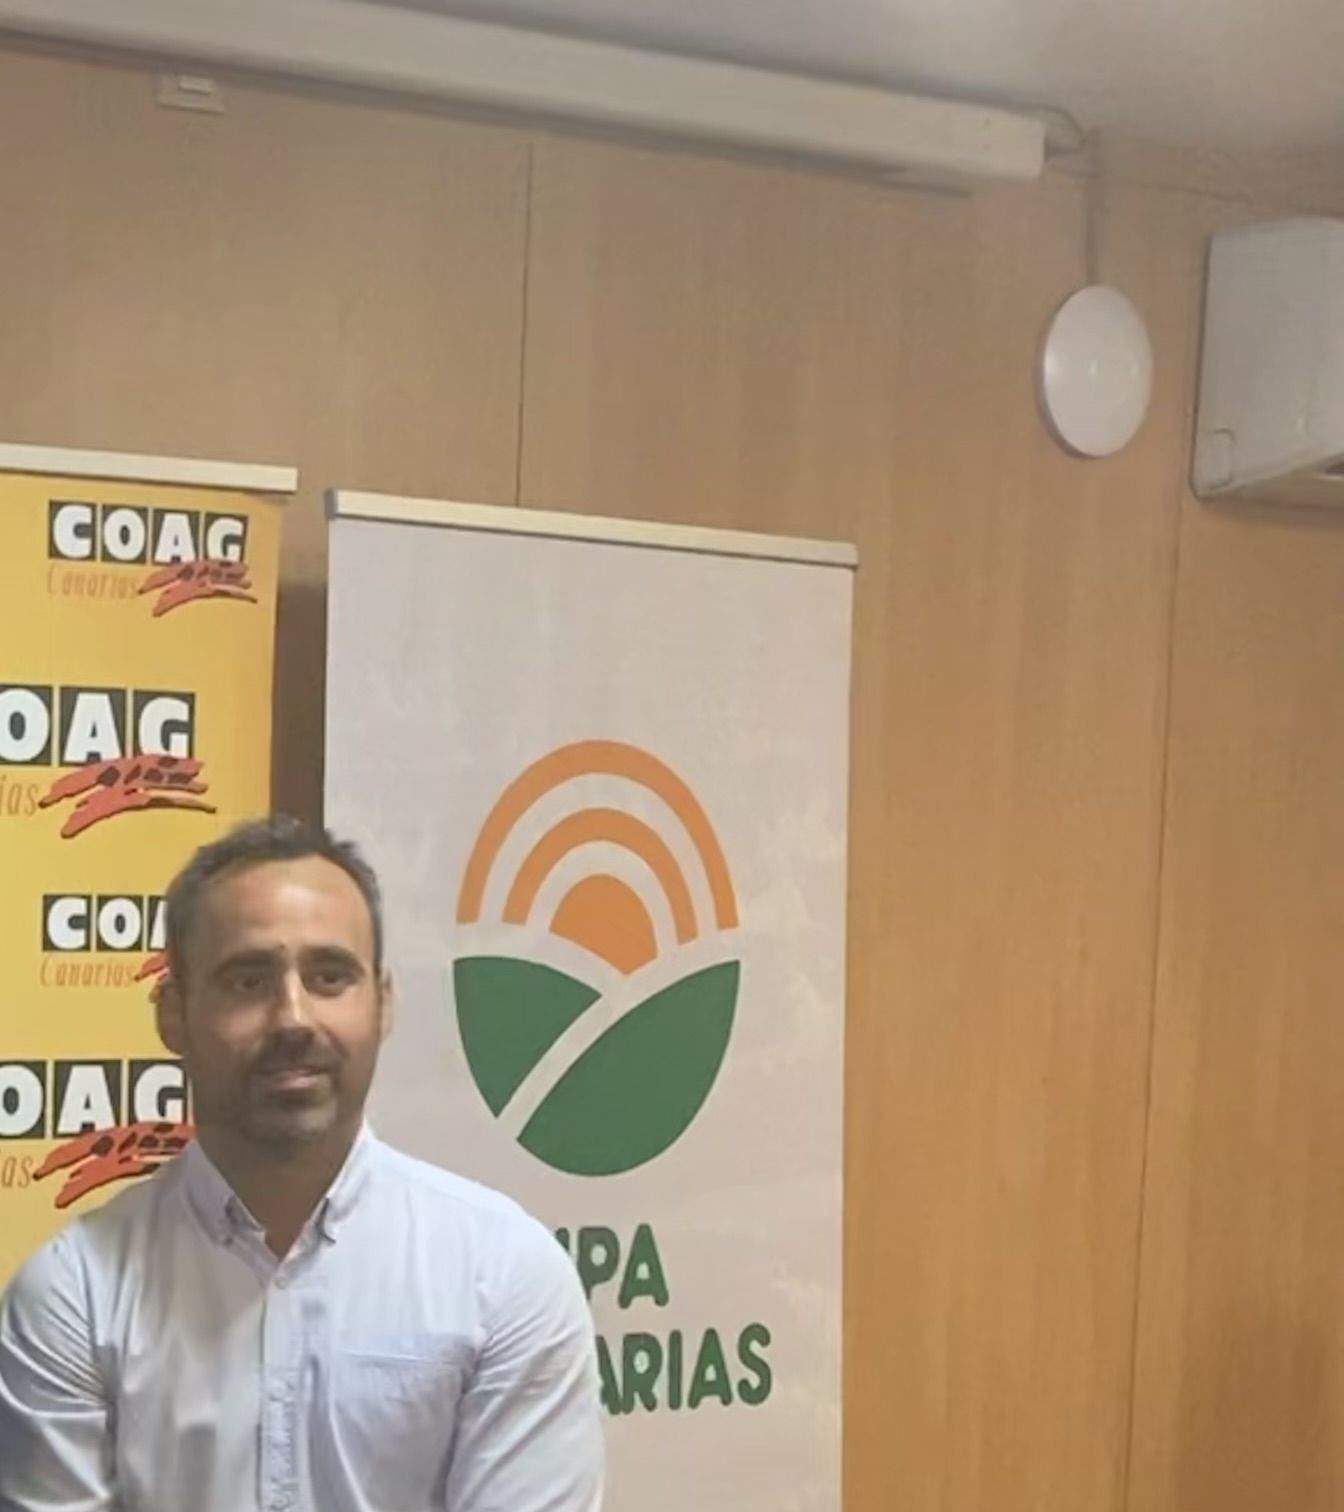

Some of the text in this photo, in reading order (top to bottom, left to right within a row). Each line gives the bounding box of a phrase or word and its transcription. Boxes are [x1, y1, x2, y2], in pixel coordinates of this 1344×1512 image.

[49, 500, 248, 564] COAG
[46, 563, 139, 599] Canarias
[40, 956, 137, 988] Canarias
[555, 1223, 669, 1309] PA
[596, 1322, 772, 1414] ARIAS
